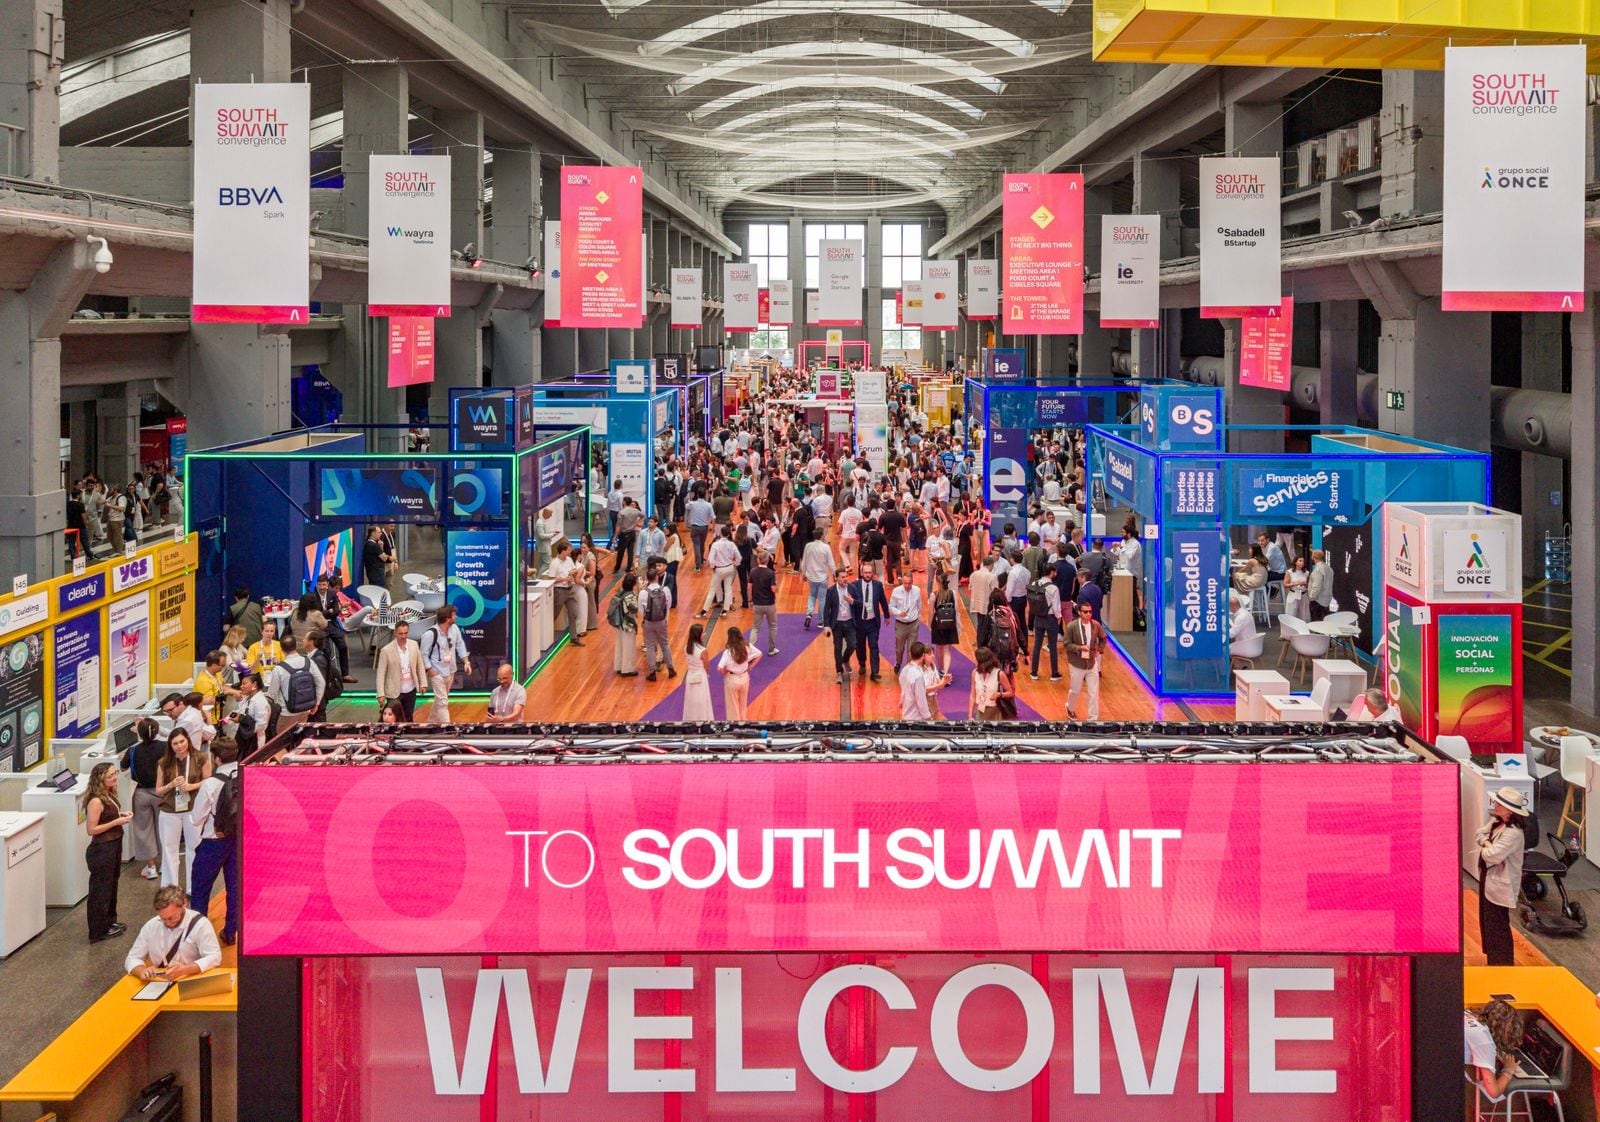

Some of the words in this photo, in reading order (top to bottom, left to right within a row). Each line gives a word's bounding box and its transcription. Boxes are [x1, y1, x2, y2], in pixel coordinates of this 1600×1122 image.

[1472, 74, 1545, 89] SOUTH
[1472, 90, 1559, 105] SUMMIT
[218, 108, 276, 122] SOUTH
[1472, 105, 1557, 116] convergence
[218, 123, 288, 136] SUMMIT
[218, 137, 286, 147] convergence
[386, 172, 427, 181] SOUTH
[1216, 175, 1257, 184] SOUTH
[1498, 177, 1548, 188] ONCE
[385, 182, 436, 191] SUMMIT
[1216, 184, 1265, 193] SUMMIT
[219, 186, 283, 205] BBVA
[264, 211, 284, 219] Spark
[405, 230, 433, 239] wayra
[1118, 264, 1133, 278] ie
[994, 359, 1008, 372] ie
[473, 424, 497, 432] wayra
[994, 432, 1002, 440] ie
[1177, 472, 1186, 512] Expertise
[1187, 472, 1196, 512] Expertise
[1196, 472, 1205, 512] Expertise
[1205, 472, 1215, 512] Expertise
[1254, 471, 1328, 512] Services
[1330, 472, 1340, 509] Startup
[400, 496, 423, 505] wayra
[120, 558, 147, 582] yes
[1396, 563, 1412, 576] ONCE
[16, 580, 26, 590] 145
[1457, 576, 1491, 584] ONCE
[68, 582, 97, 601] clearly
[1180, 543, 1201, 632] Sabadell
[16, 604, 39, 616] Guiding
[1206, 578, 1218, 631] BStartup
[1456, 650, 1494, 658] SOCIAL
[112, 690, 128, 707] yes
[505, 830, 595, 888] TO
[622, 828, 869, 889] SOUTH
[886, 828, 1182, 889] SUMMIT
[416, 963, 1337, 1095] WELCOME
